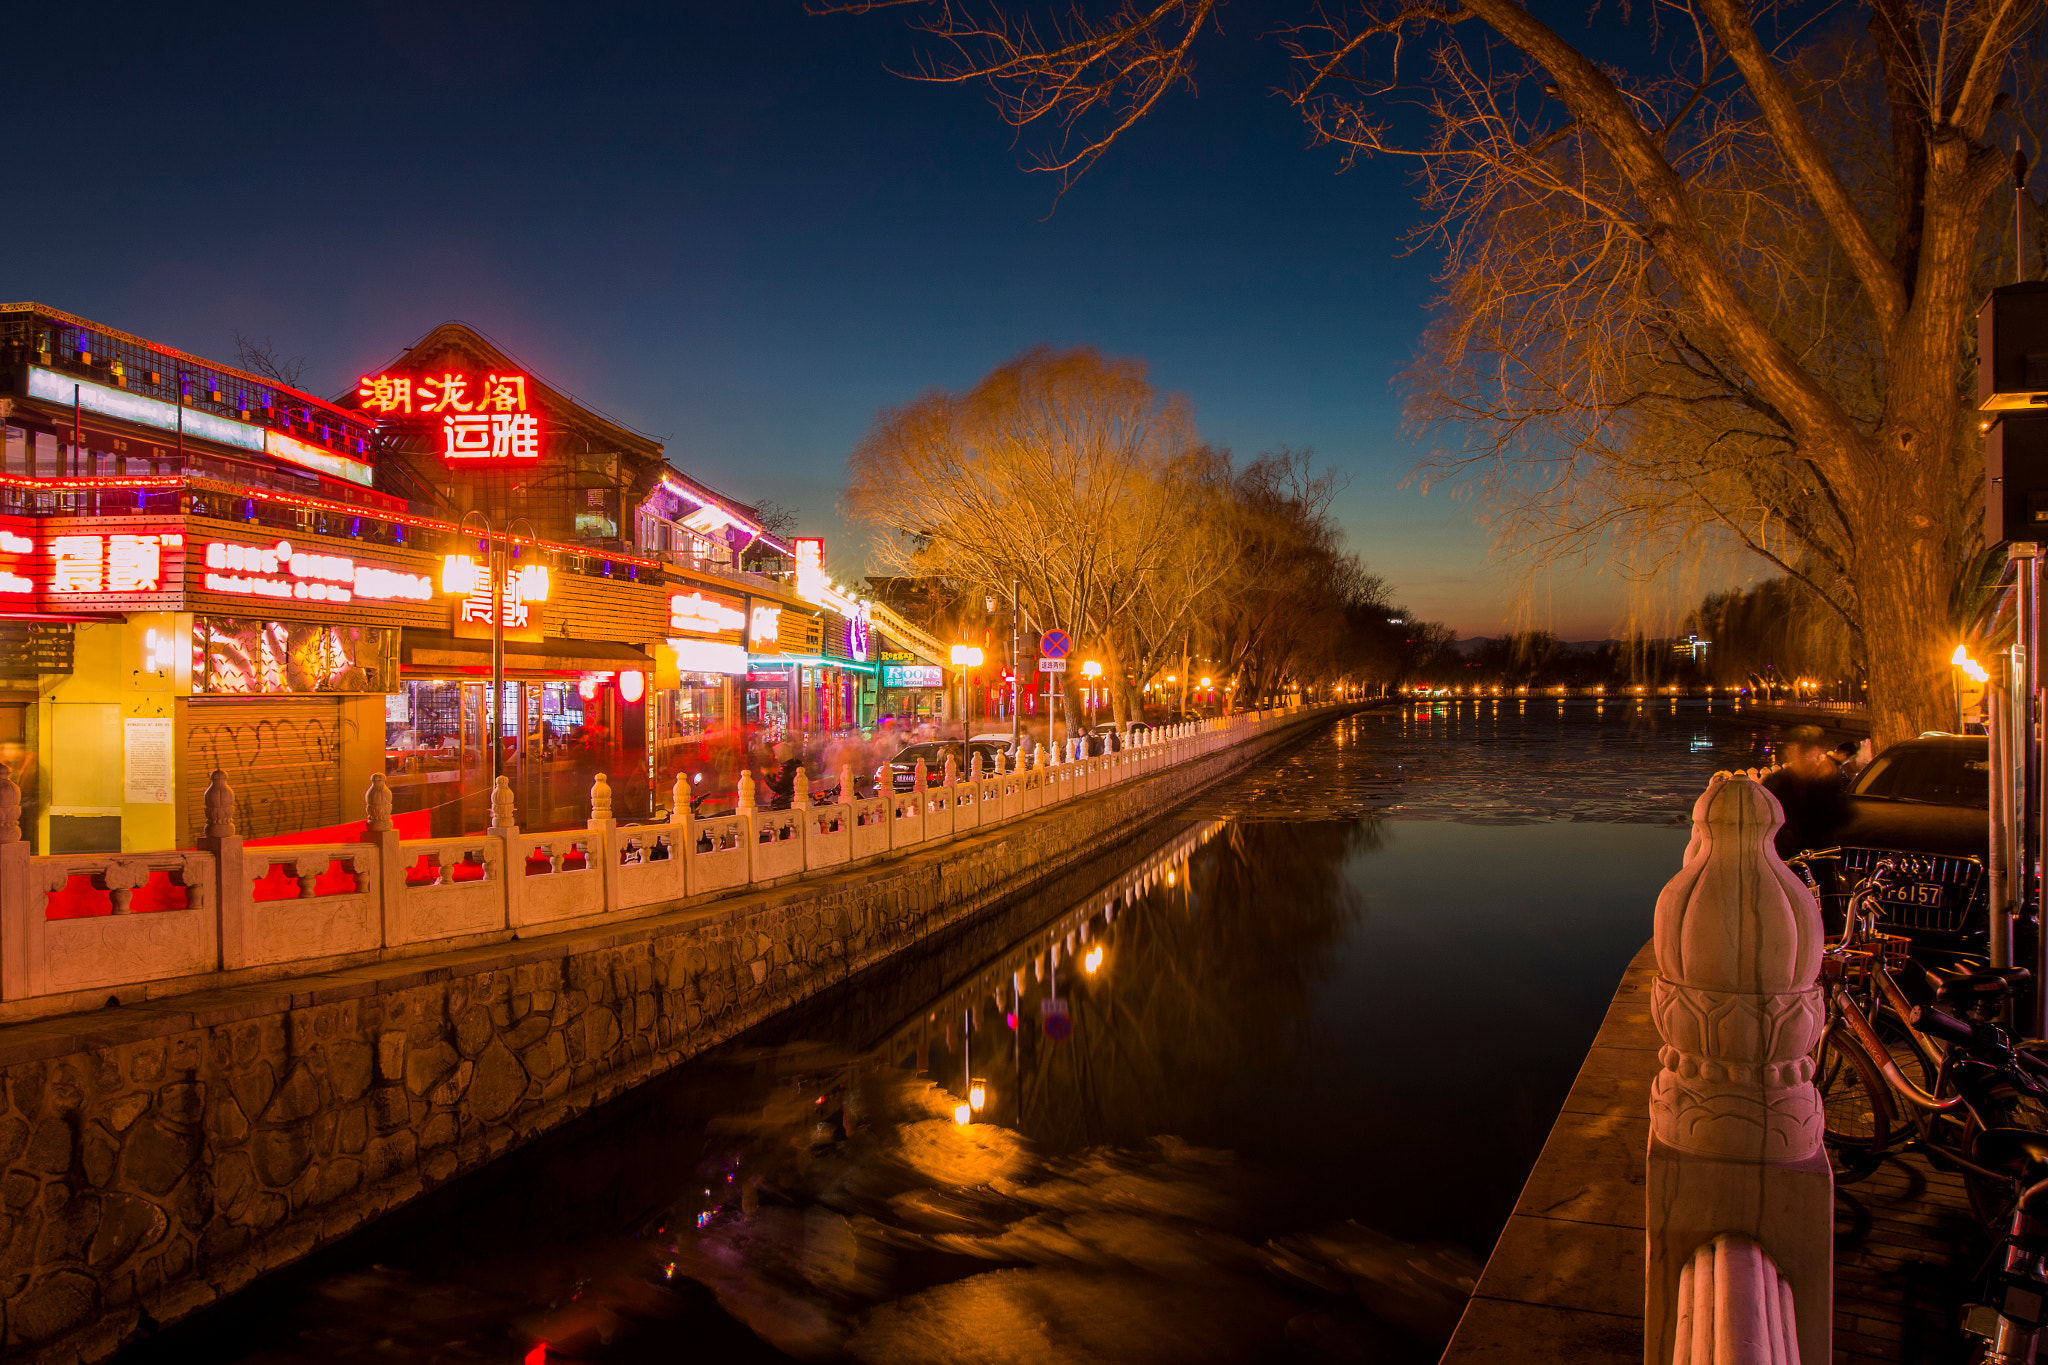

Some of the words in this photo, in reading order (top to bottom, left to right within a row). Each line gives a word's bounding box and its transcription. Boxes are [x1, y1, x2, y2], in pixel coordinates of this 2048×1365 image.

[359, 373, 527, 413] 潮泷阁
[444, 414, 538, 458] 运雅
[1041, 661, 1065, 670] 道路两侧
[1853, 1021, 1882, 1064] mobike
